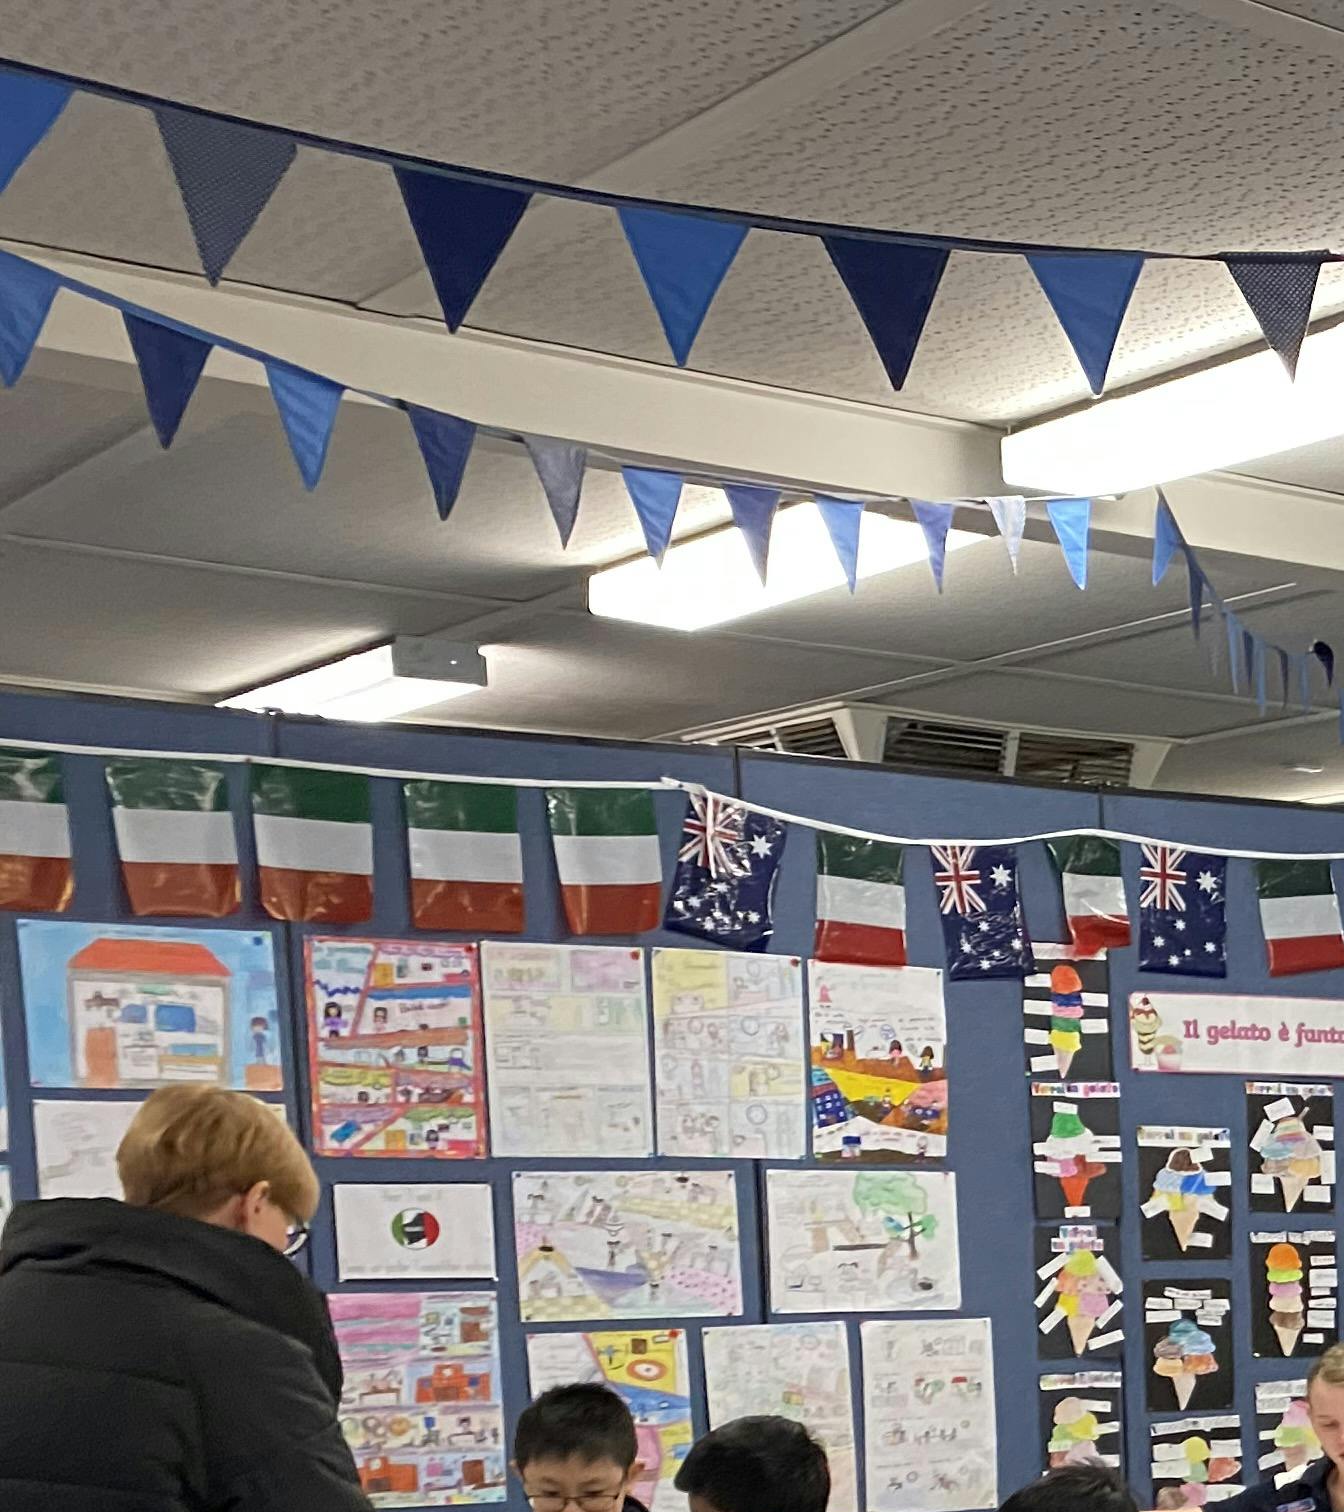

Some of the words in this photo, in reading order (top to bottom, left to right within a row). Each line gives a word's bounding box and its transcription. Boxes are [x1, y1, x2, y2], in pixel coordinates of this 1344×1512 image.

[1183, 1019, 1200, 1039] Il
[1207, 1020, 1271, 1045] gelato
[1278, 1021, 1290, 1042] è
